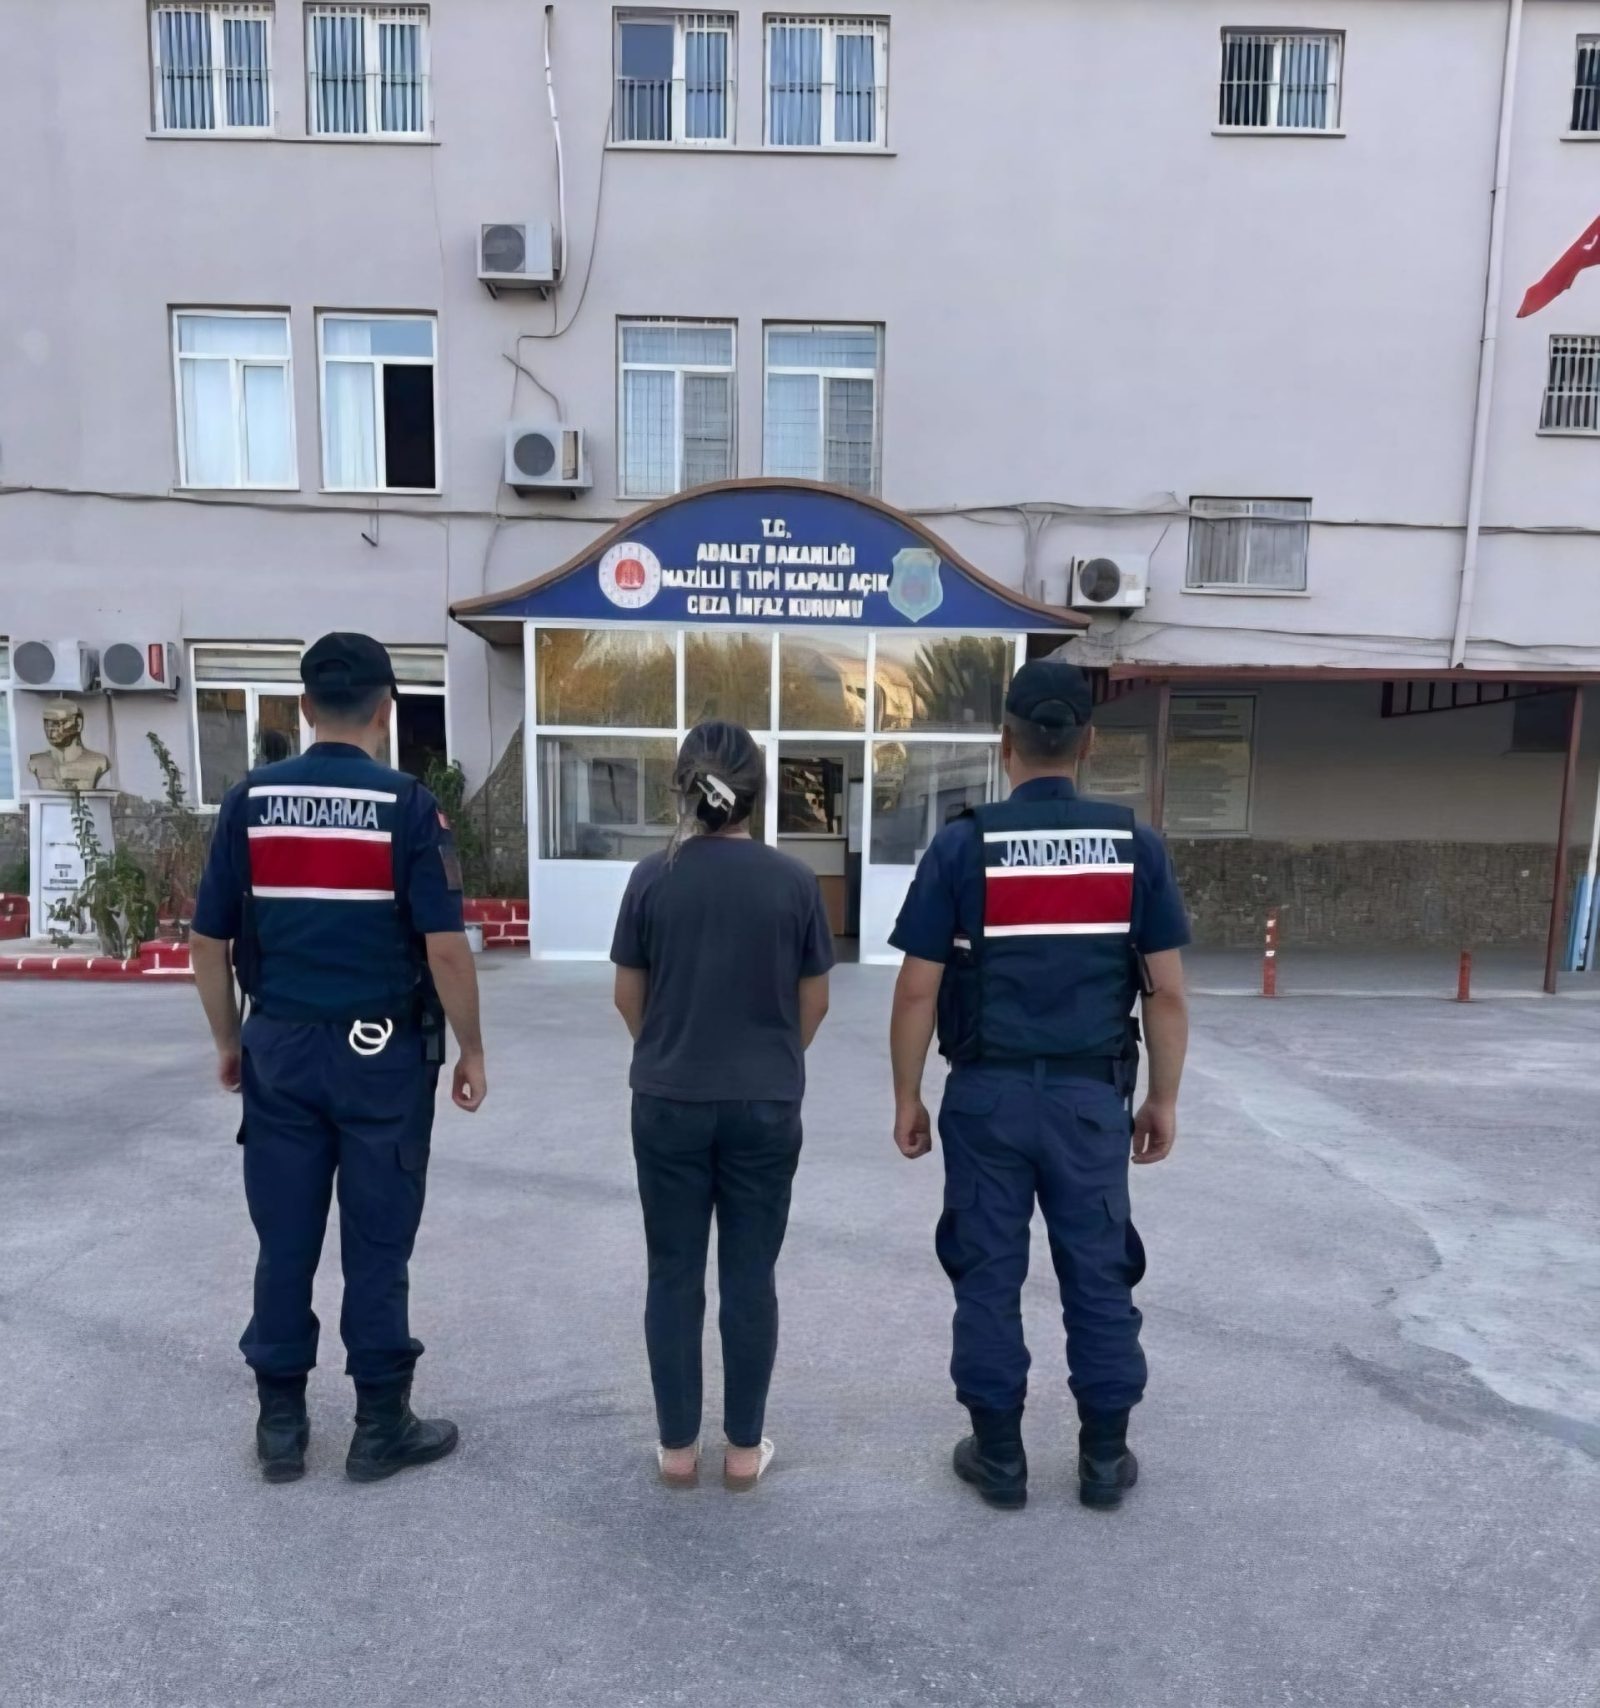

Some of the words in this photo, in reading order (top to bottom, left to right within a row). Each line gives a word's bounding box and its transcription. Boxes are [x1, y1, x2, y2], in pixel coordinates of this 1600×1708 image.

[697, 543, 760, 564] ADALET
[765, 542, 855, 566] BAKANLIĞI
[731, 569, 741, 590] E
[747, 566, 780, 591] TİPİ
[785, 571, 844, 592] KAPALI
[848, 572, 890, 597] AÇIK
[687, 595, 731, 615] CEZA
[735, 591, 784, 616] İNFAZ
[788, 596, 864, 619] KURUMU
[260, 796, 379, 829] JANDARMA
[1000, 838, 1119, 867] JANDARMA
